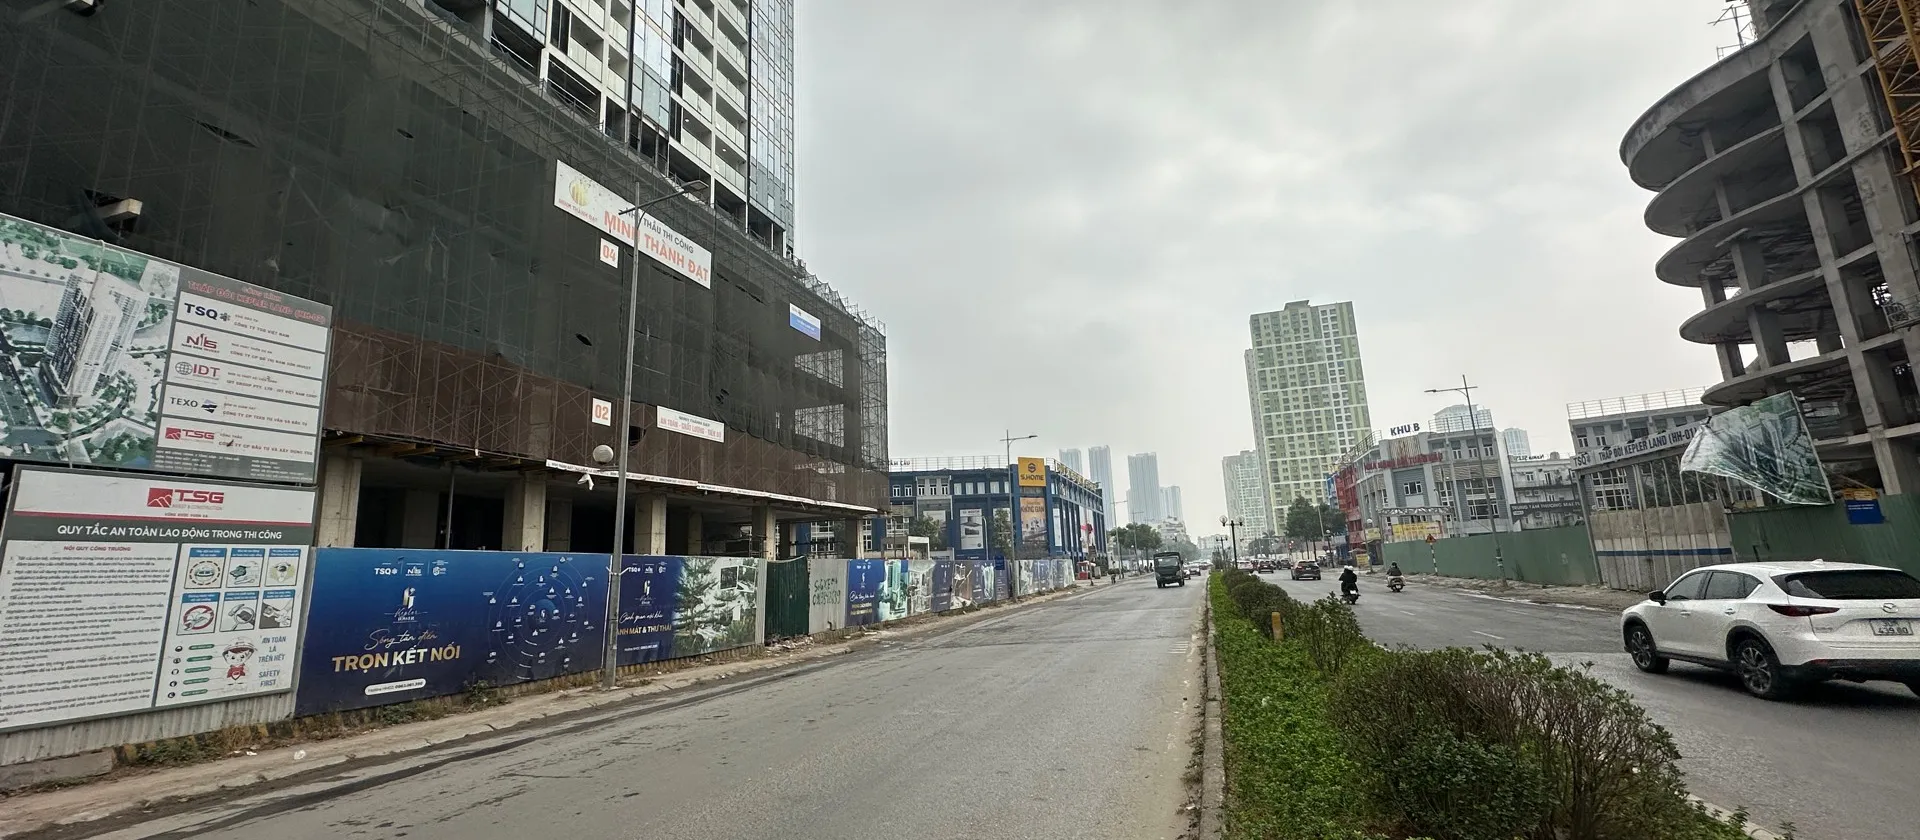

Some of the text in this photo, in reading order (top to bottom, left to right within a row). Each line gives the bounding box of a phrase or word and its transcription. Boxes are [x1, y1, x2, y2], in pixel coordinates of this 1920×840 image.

[644, 216, 662, 234] THẦU
[663, 229, 673, 242] THI
[674, 235, 694, 254] CÔNG
[603, 245, 616, 261] 04
[644, 233, 687, 268] THÀNH
[688, 259, 709, 282] ĐẠT
[188, 280, 214, 293] THÁP
[184, 303, 217, 320] TSQ
[192, 364, 220, 377] IDT
[170, 397, 198, 408] TEXO
[595, 404, 609, 419] 02
[182, 429, 215, 439] TSG
[1390, 423, 1420, 436] KHU B
[1598, 449, 1612, 461] THÁP
[1624, 442, 1648, 454] KEPLER
[1648, 435, 1667, 448] LAND
[1668, 427, 1697, 445] (HH-01)
[1574, 454, 1586, 466] TSQ
[174, 489, 224, 504] TSG
[57, 522, 282, 540] QUY TẮC AN TOÀN LAO ĐỘNG TRONG THI CÔNG
[629, 625, 642, 634] MÁT
[332, 642, 460, 674] TRỌN KẾT NỐI
[259, 670, 280, 678] SAFETY
